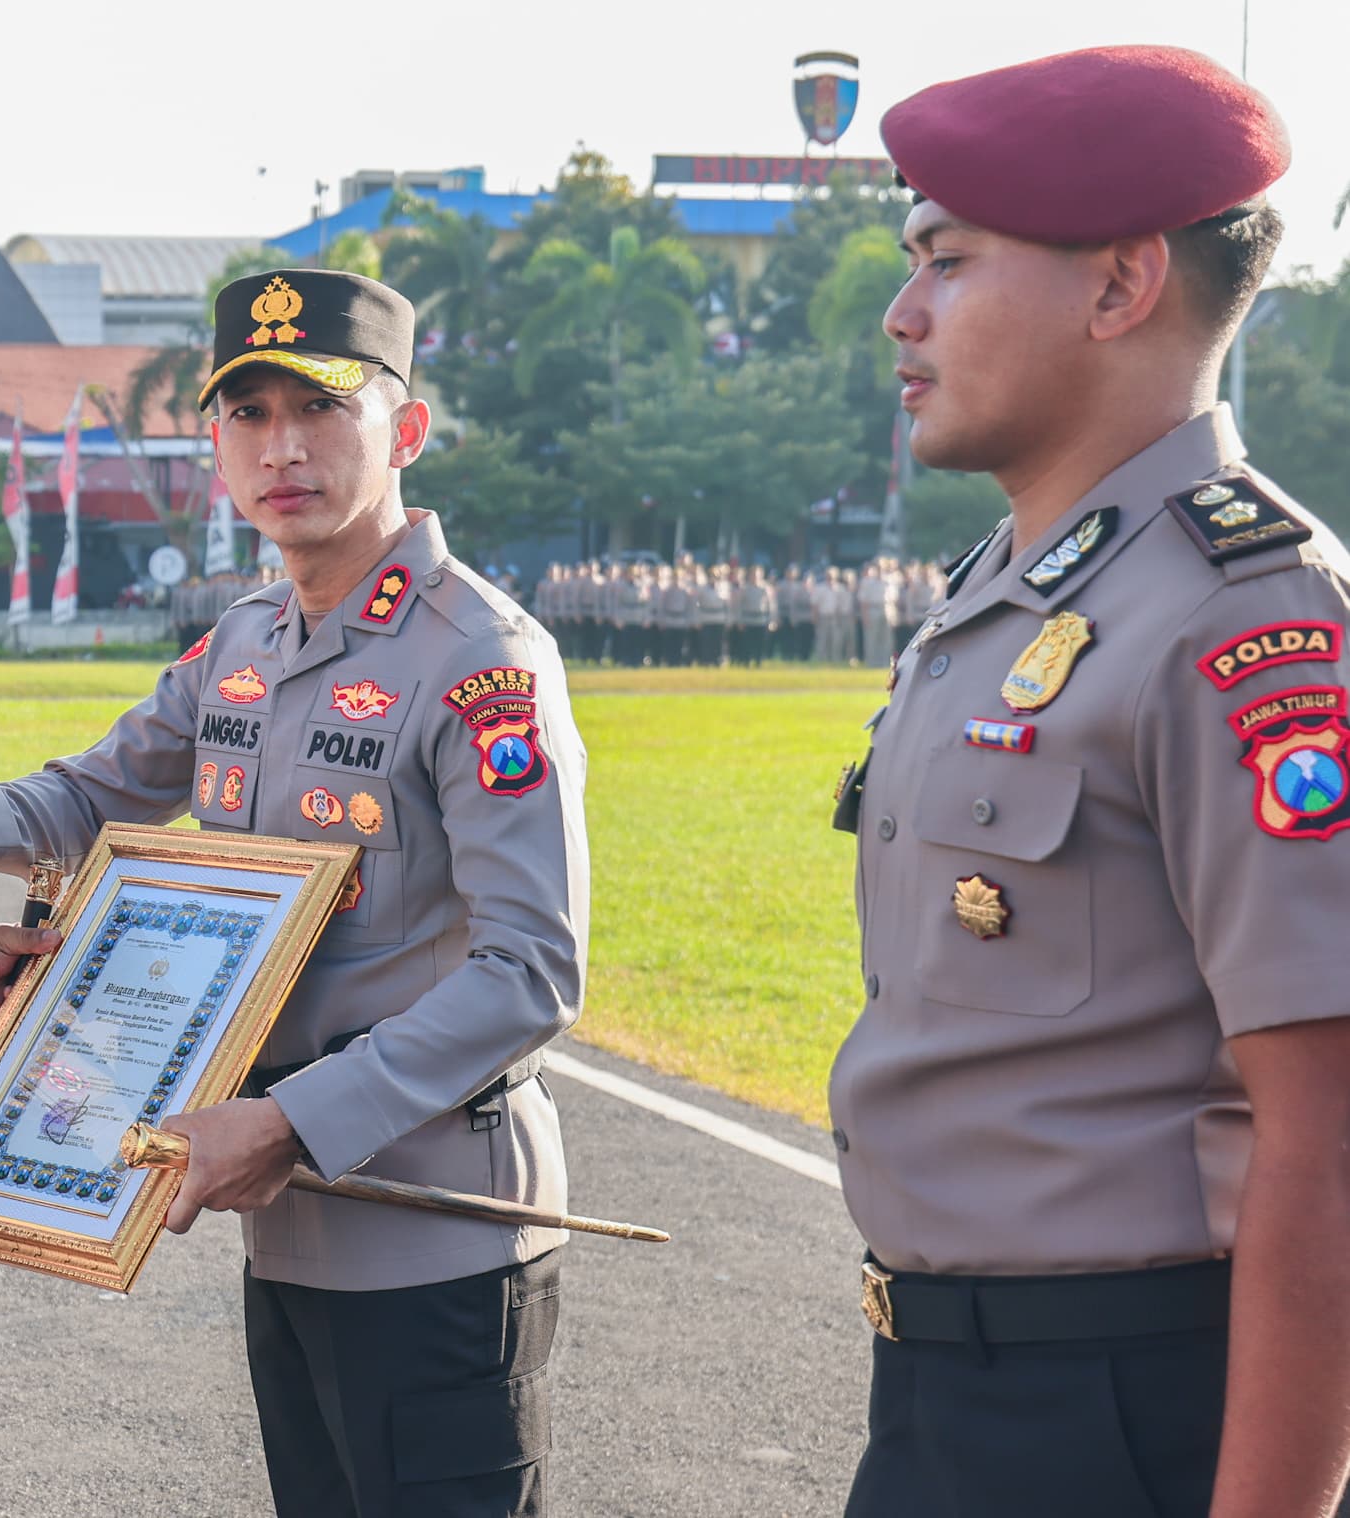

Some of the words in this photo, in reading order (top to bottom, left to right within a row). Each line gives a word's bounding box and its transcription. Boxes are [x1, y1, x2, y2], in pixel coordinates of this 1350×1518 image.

[1214, 630, 1329, 676] POLDA
[449, 670, 531, 702] POLRES
[458, 683, 496, 707] KEDIRI
[499, 681, 529, 694] KOTA
[471, 706, 498, 723] JAWA
[498, 704, 531, 713] TIMUR
[1242, 702, 1283, 730] JAWA
[1282, 694, 1338, 711] TIMUR
[199, 713, 261, 750] ANGGI.S
[307, 730, 385, 771] POLRI
[104, 983, 136, 996] Piagam
[137, 987, 191, 1005] Penghargaan
